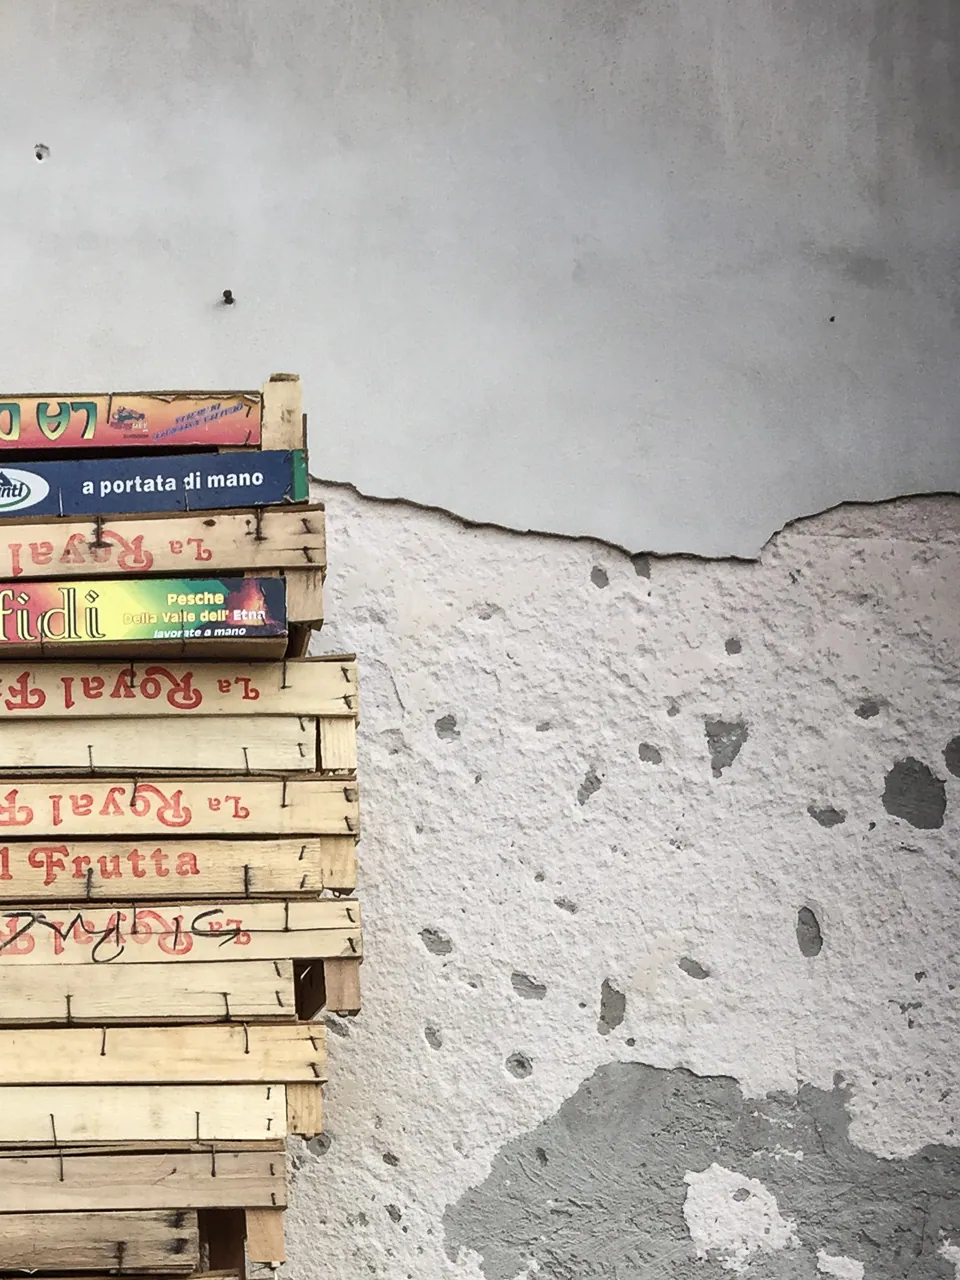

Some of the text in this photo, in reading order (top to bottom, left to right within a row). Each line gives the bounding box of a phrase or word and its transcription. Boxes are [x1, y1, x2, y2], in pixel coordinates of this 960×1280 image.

[36, 401, 97, 441] LA
[82, 472, 265, 498] a portata di mano
[8, 530, 155, 577] Royal
[169, 537, 213, 563] La
[167, 591, 225, 606] Pesche
[123, 608, 266, 625] Della Valle dell' Etna
[153, 627, 247, 639] lavorate a mano
[62, 667, 204, 711] Royal
[218, 677, 261, 702] La
[51, 784, 194, 828] Royal
[209, 796, 252, 821] La
[28, 845, 202, 887] Frutta
[52, 910, 195, 956] Royal
[209, 919, 253, 947] La
